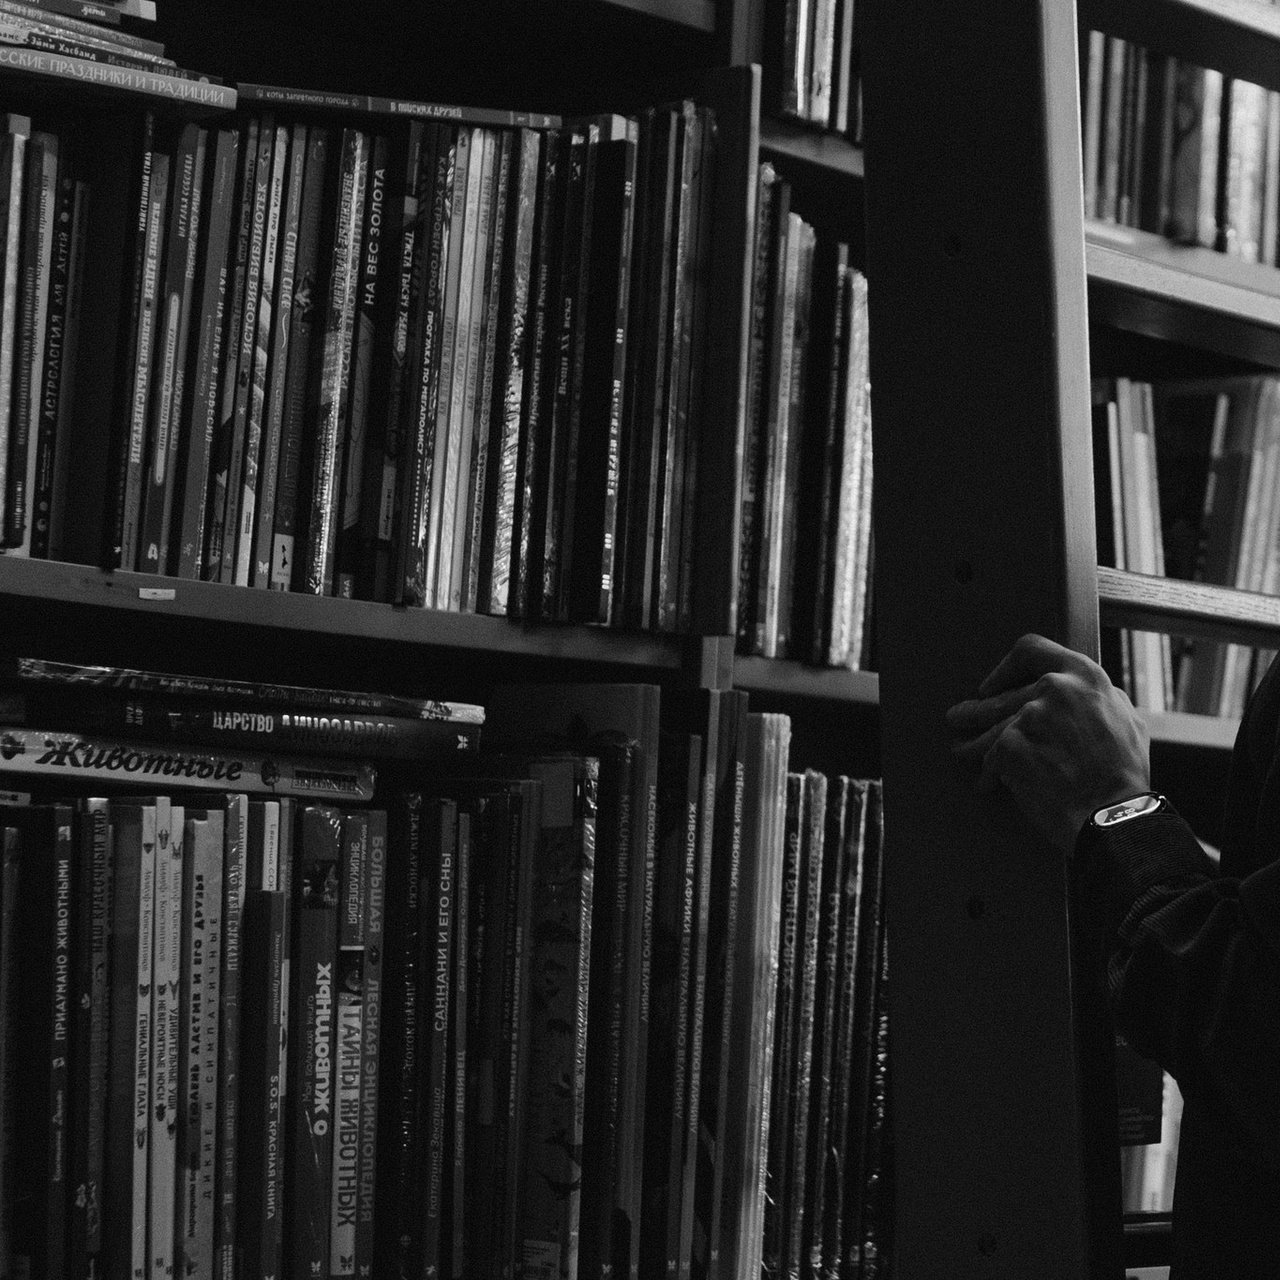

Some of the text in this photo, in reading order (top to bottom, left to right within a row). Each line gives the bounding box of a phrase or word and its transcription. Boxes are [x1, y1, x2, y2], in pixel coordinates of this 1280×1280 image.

[50, 58, 133, 86] ПРАЗДНИКИ
[135, 73, 147, 88] И
[150, 77, 225, 104] ТРАДИЦИИ
[144, 201, 161, 300] ВЕЛИКИЕ ИДЕИ
[242, 182, 267, 356] ИСТОРИЯ БИБЛИОТЕК
[364, 167, 385, 306] НА ВЕС ЗОЛОТА
[416, 155, 446, 455] КАК УСТРОЕН ГОРОД? ПРОГУЛКА ПО МЕГАПОЛИСУ
[44, 313, 63, 421] АСТРОЛОГИЯ
[130, 310, 152, 465] ВЕЛИКИЕ МЫСЛИТЕЛИ
[35, 735, 244, 783] Животные
[212, 710, 275, 734] ЦАРСТВО
[647, 784, 657, 860] НАСЕКОМЫЕ
[686, 801, 697, 875] ЖИВОТНЫЕ
[91, 809, 106, 953] НАШ КРАСОЧНЫЙ МИР
[193, 874, 205, 930] ДРУЗЬЯ
[439, 851, 452, 892] СНЫ
[683, 877, 693, 934] АФРИКИ
[436, 931, 448, 944] И
[438, 896, 449, 927] ЕГО
[643, 871, 654, 959] НАТУРАЛЬНУЮ
[55, 858, 69, 1041] ПРИДУМАНО ЖИВОТНЫМИ
[193, 973, 202, 985] И
[194, 939, 203, 965] ЕГО
[190, 993, 201, 1056] ЛАСТИК
[205, 917, 218, 1084] СИМПАТИЧНЫЕ
[433, 947, 448, 1032] САННАНИ
[641, 960, 651, 1023] ВЕЛИЧИНУ
[677, 946, 690, 1046] НАТУРАЛЬНУЮ
[157, 998, 166, 1071] НЕВЕРОЯТНЫЕ
[338, 841, 361, 1227] ЭНЦИКЛОПЕДИЯ ТАЙНЫ ЖИВОТНЫХ
[360, 835, 383, 1222] БОЛЬШАЯ ЛЕСНАЯ ЭНЦИКЛОПЕДИЯ
[693, 984, 705, 1070] НАТУРАЛЬНУЮ
[189, 1063, 200, 1126] ТЮЛЕНЬ
[674, 1049, 685, 1119] ВЕЛИЧИНУ
[203, 1127, 213, 1200] ДИКИЕ
[266, 1074, 278, 1221] S.O.S. КРАСНАЯ КНИГА
[427, 1150, 441, 1219] Екатерина
